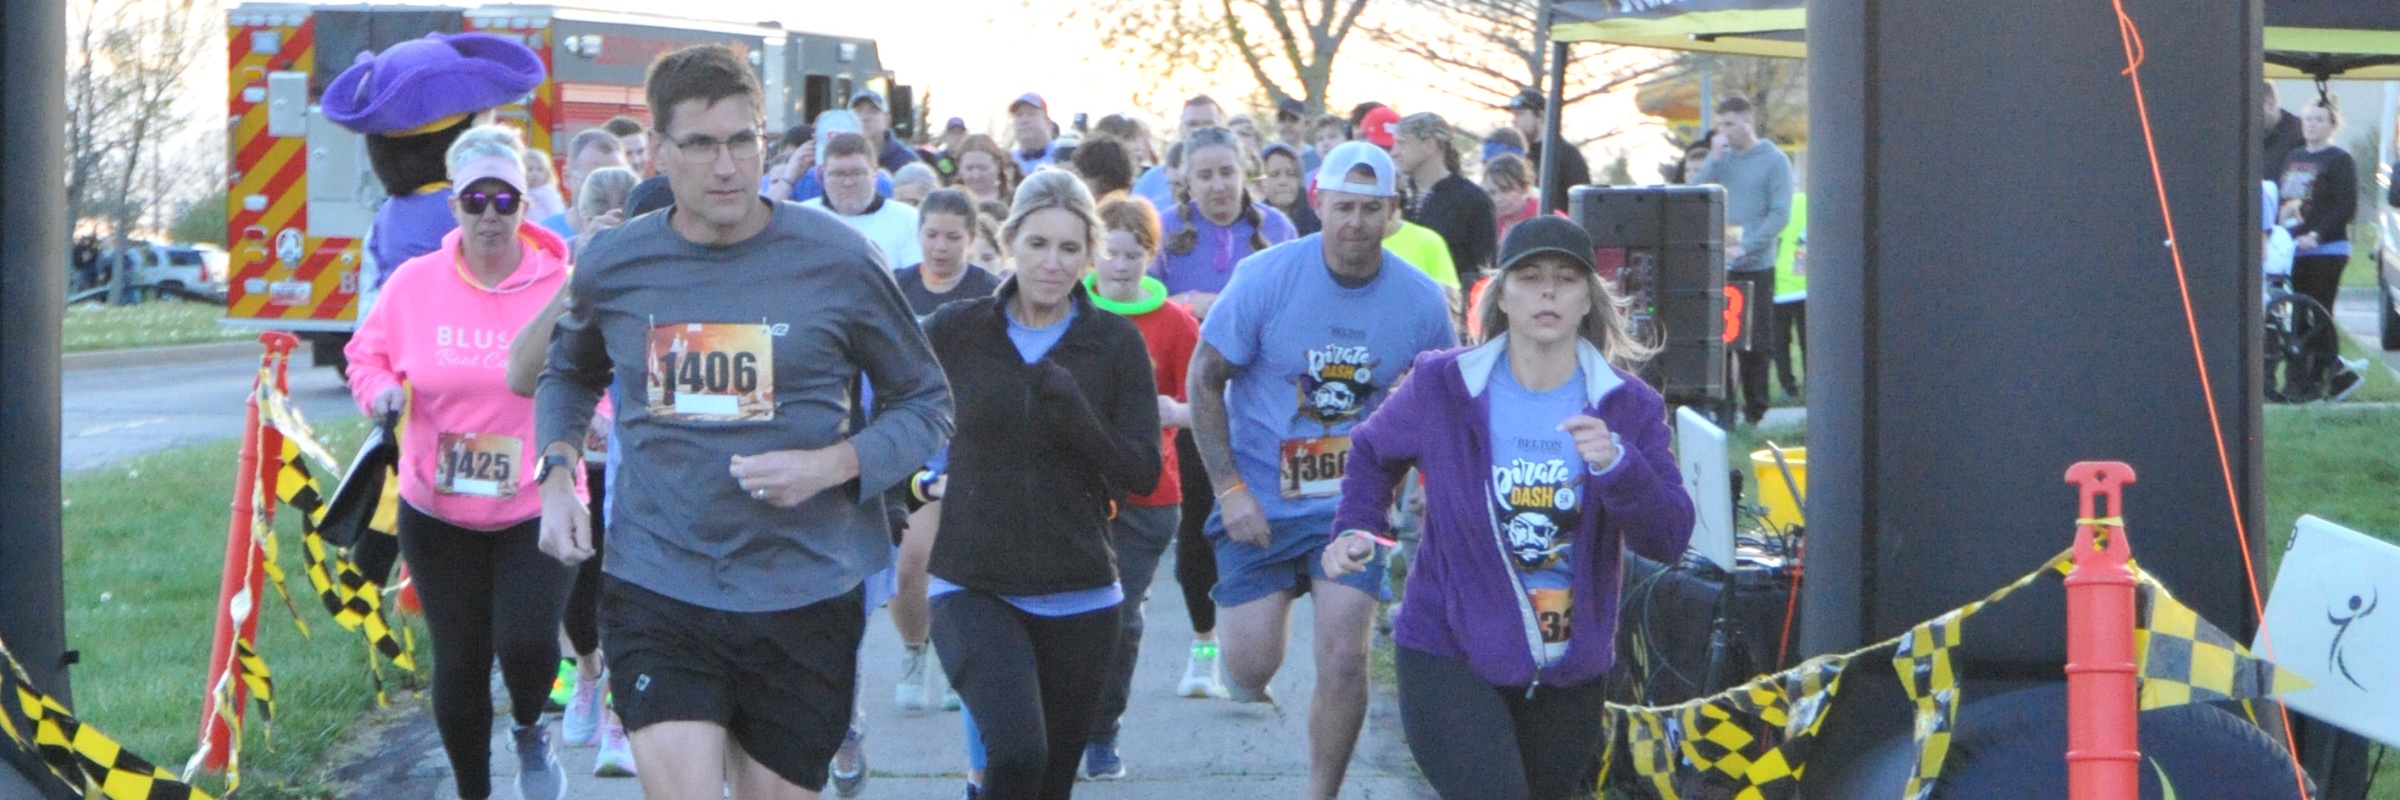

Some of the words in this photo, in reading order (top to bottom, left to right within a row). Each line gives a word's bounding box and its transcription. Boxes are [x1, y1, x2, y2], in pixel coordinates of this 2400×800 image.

[659, 350, 757, 396] 1406
[445, 451, 510, 482] 1425
[1511, 486, 1554, 508] DASH
